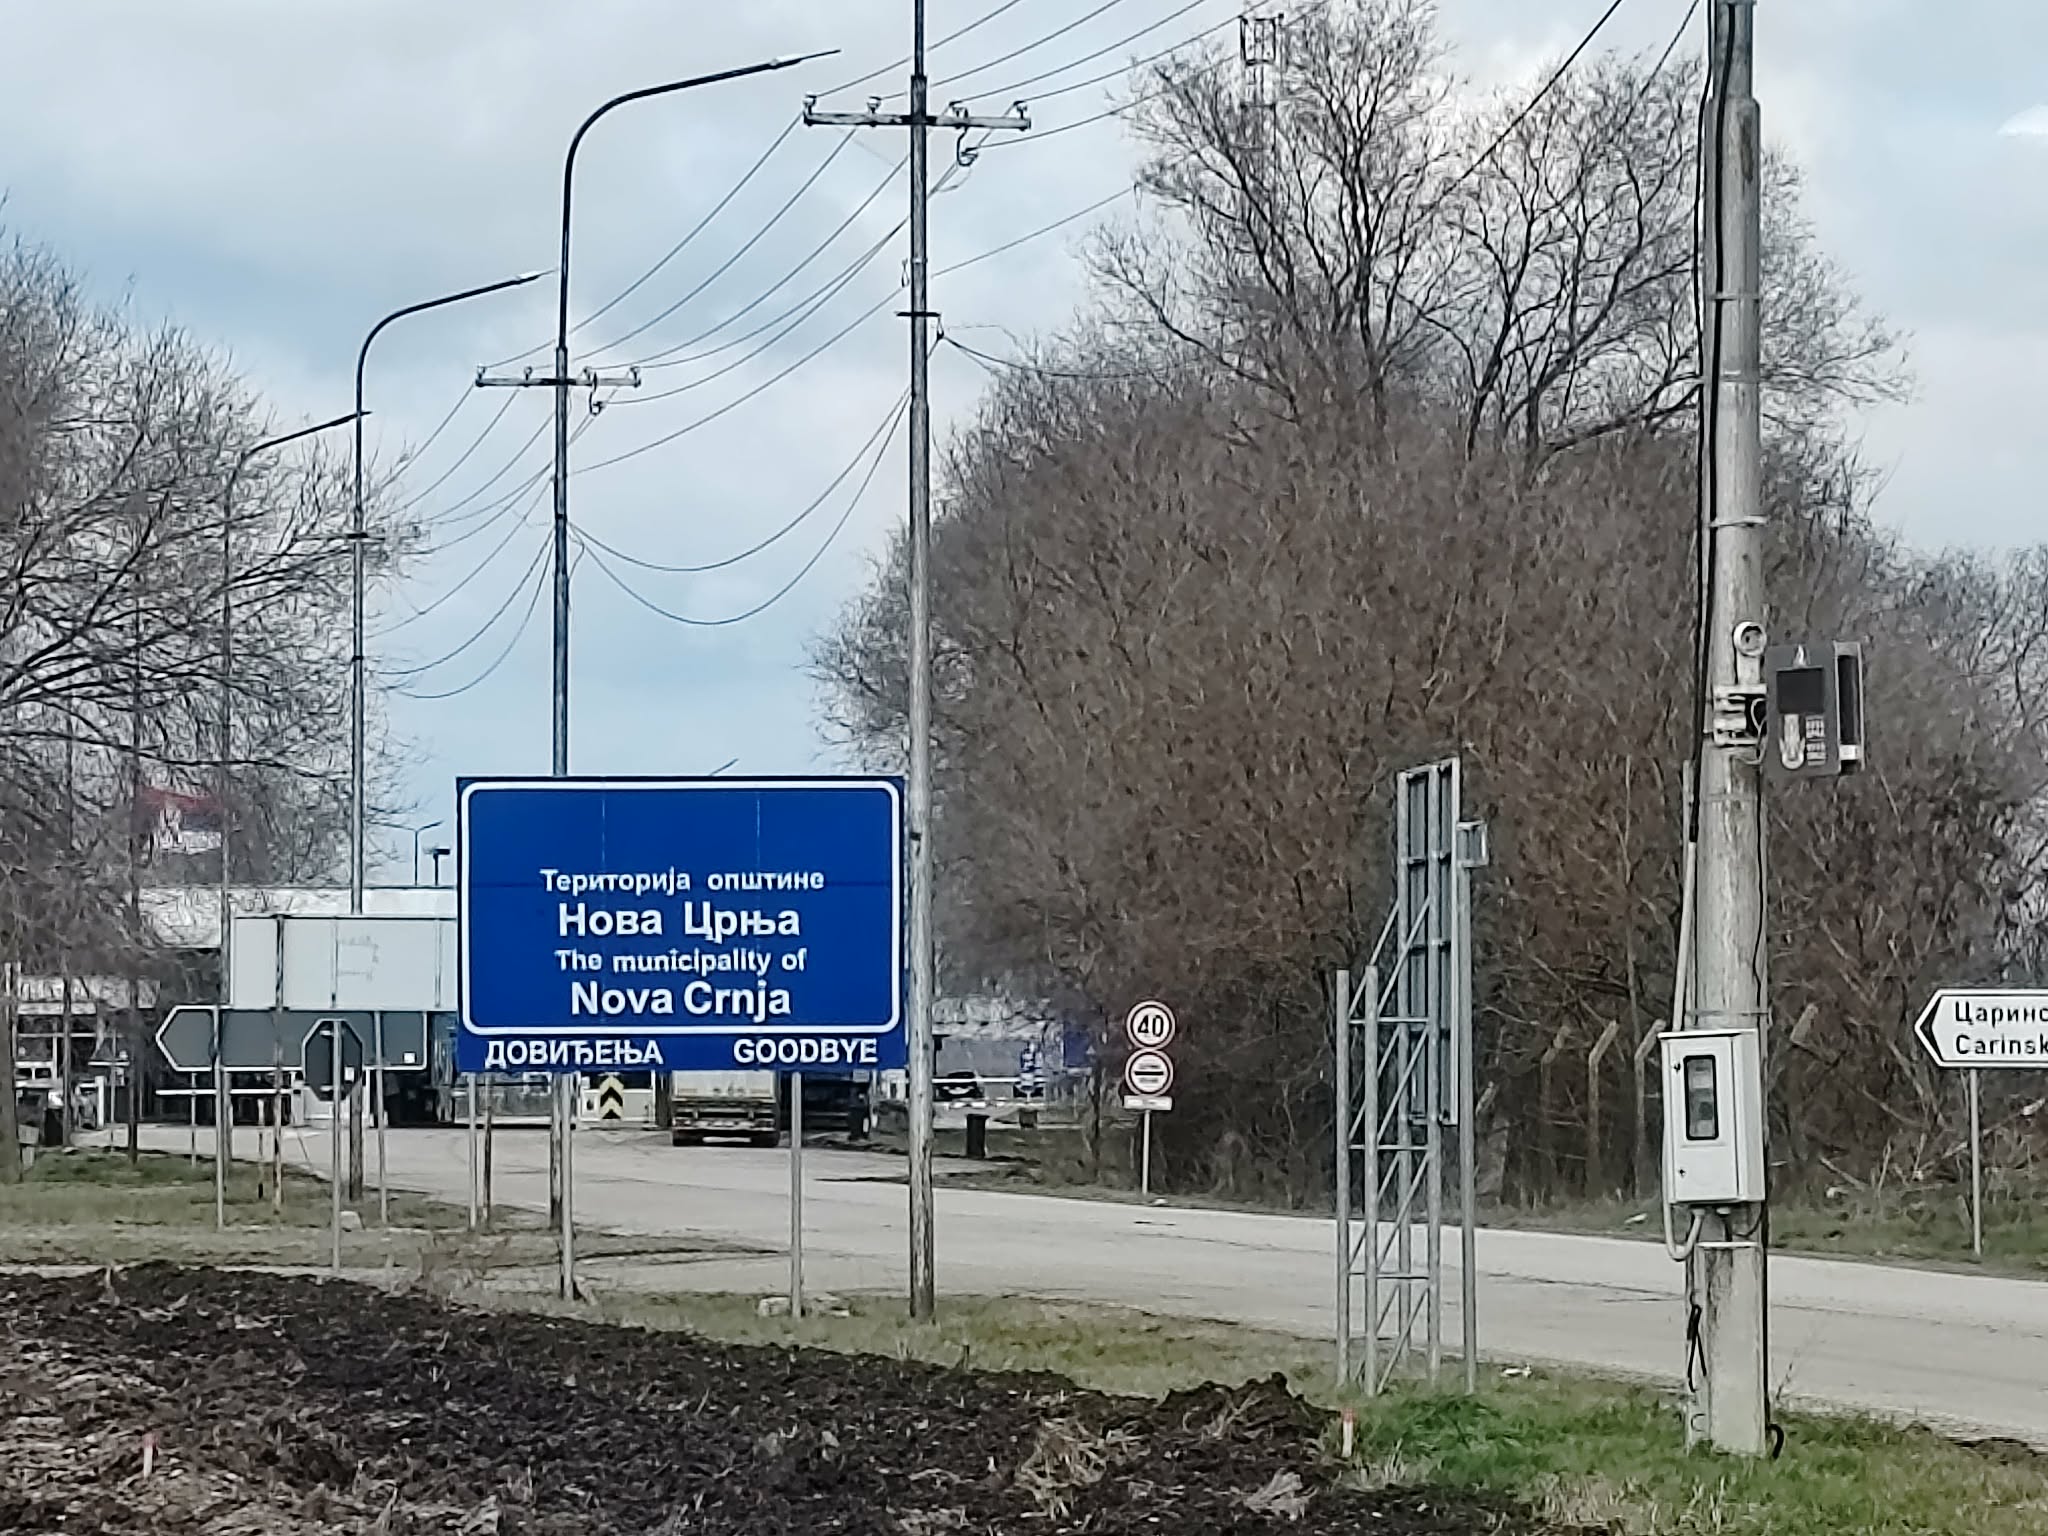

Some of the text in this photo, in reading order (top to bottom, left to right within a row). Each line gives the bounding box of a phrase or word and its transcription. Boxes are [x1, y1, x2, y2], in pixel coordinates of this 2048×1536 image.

[540, 866, 825, 896] Територија општине
[558, 901, 801, 943] Нова Црња
[554, 947, 808, 977] The municipality of
[571, 980, 791, 1023] Nova Crnja
[1137, 1014, 1165, 1037] 40
[484, 1039, 664, 1069] ДОВИЂЕЊА
[733, 1037, 879, 1064] GOODBYE
